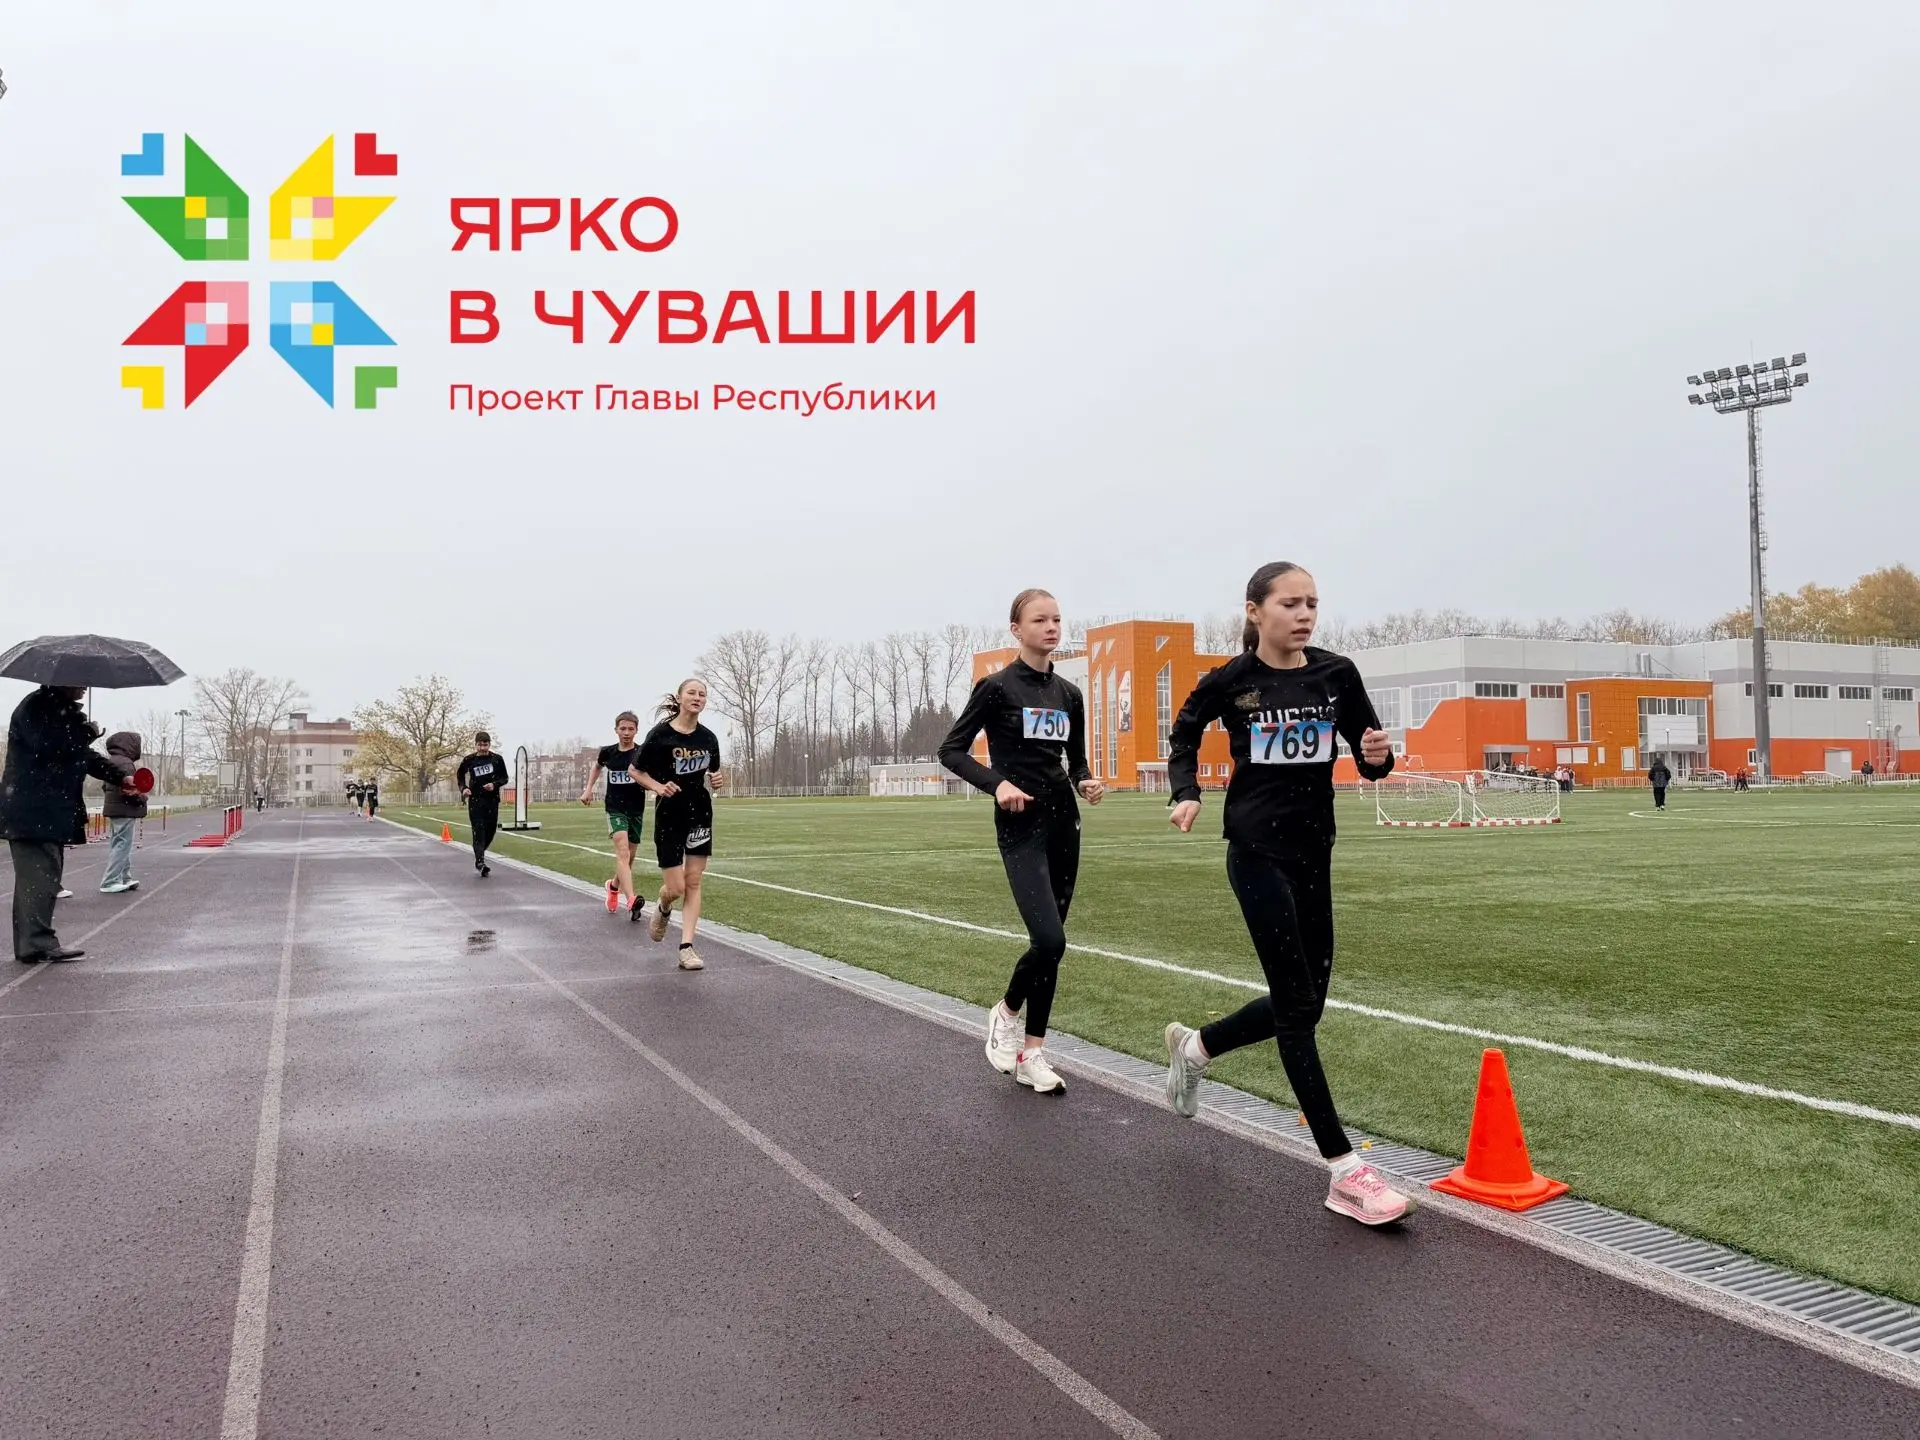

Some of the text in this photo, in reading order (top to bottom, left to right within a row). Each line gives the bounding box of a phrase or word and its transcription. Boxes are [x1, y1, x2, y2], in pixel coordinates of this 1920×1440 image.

[1030, 710, 1066, 738] 750
[1260, 724, 1320, 760] 769
[476, 765, 491, 775] 119
[679, 756, 706, 773] 207
[611, 771, 631, 783] 518
